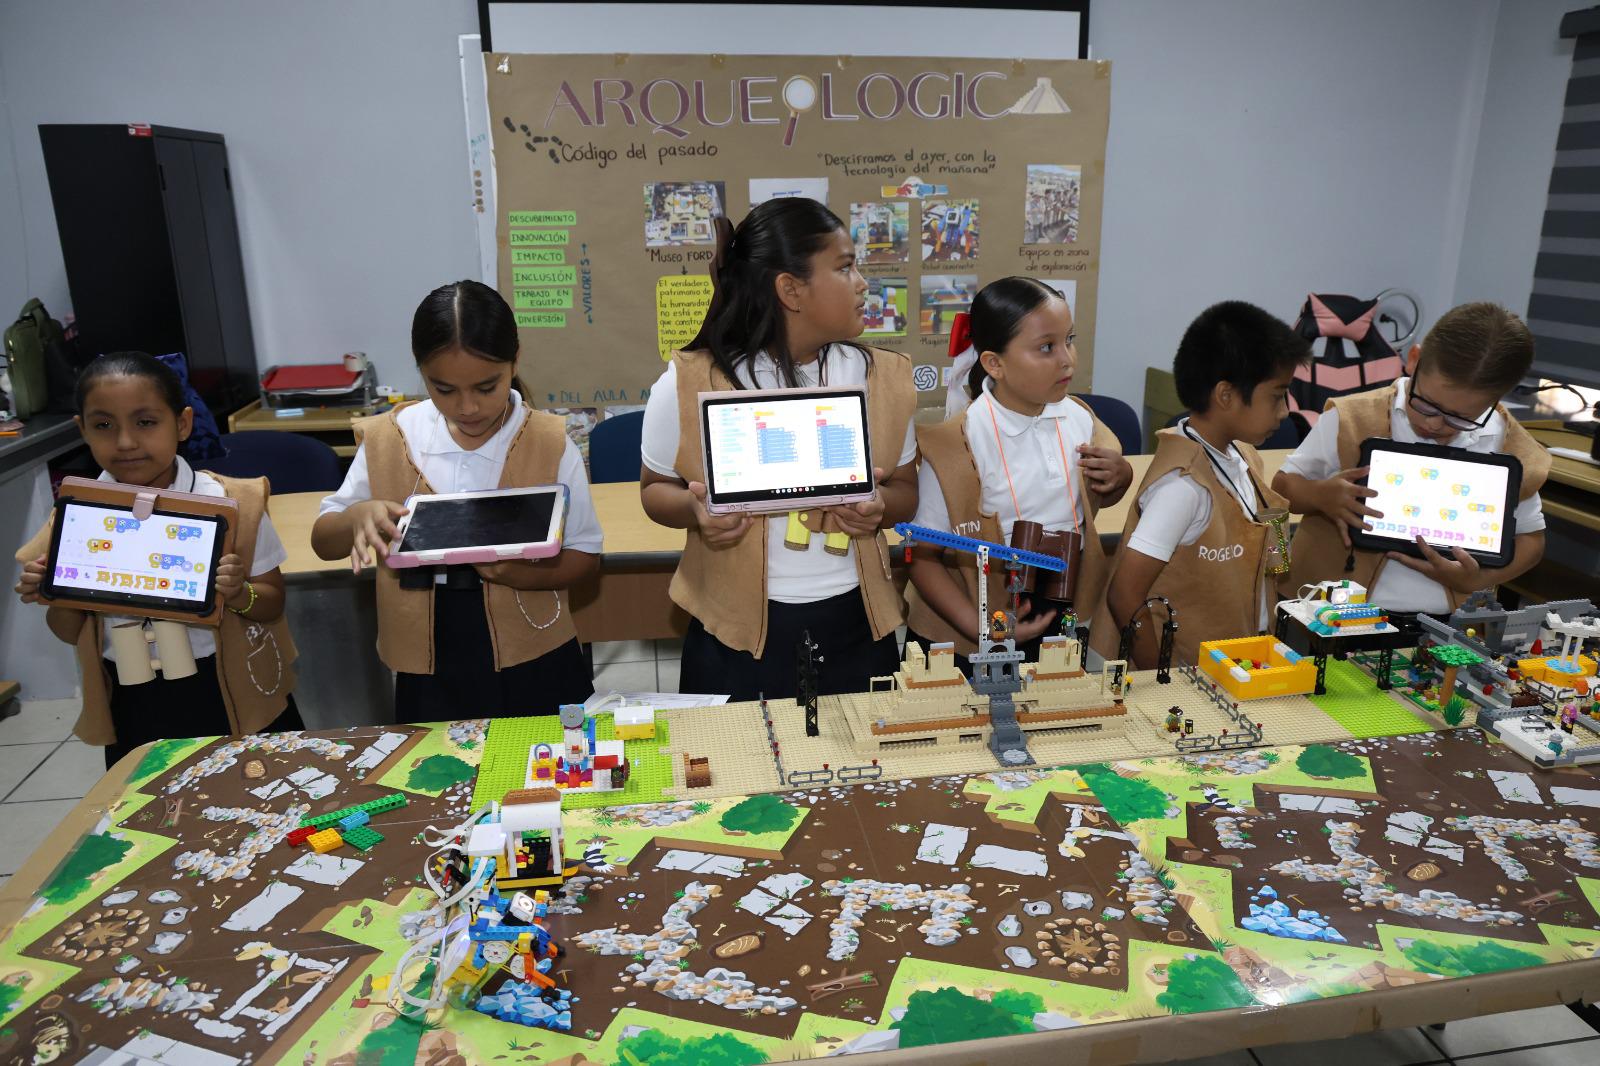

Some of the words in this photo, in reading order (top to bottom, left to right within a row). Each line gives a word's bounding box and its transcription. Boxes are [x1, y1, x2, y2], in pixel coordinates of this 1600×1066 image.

[561, 142, 617, 168] Código
[626, 143, 647, 160] del
[658, 141, 718, 165] pasado
[904, 148, 914, 161] el
[954, 153, 975, 162] con
[983, 149, 996, 162] la
[912, 163, 929, 173] del
[508, 214, 575, 223] DESCUBRIMIENTO
[511, 232, 566, 242] INNOVACIÓN
[516, 252, 562, 261] IMPACTO
[687, 250, 713, 261] FORD
[1019, 247, 1049, 260] Equipo
[1025, 261, 1038, 271] de
[1041, 261, 1087, 275] exploración
[514, 270, 573, 282] INCLUSIÓN
[580, 258, 592, 314] VALORES
[659, 279, 667, 287] El
[671, 279, 709, 287] verdadero
[516, 290, 550, 298] TRABAJO
[557, 289, 569, 297] EN
[660, 288, 701, 300] patrimonio
[660, 300, 667, 308] la
[670, 299, 710, 308] humanidad
[518, 314, 563, 324] DIVERSIÓN
[660, 320, 671, 328] que
[560, 390, 581, 403] DEL
[593, 388, 628, 402] AULA
